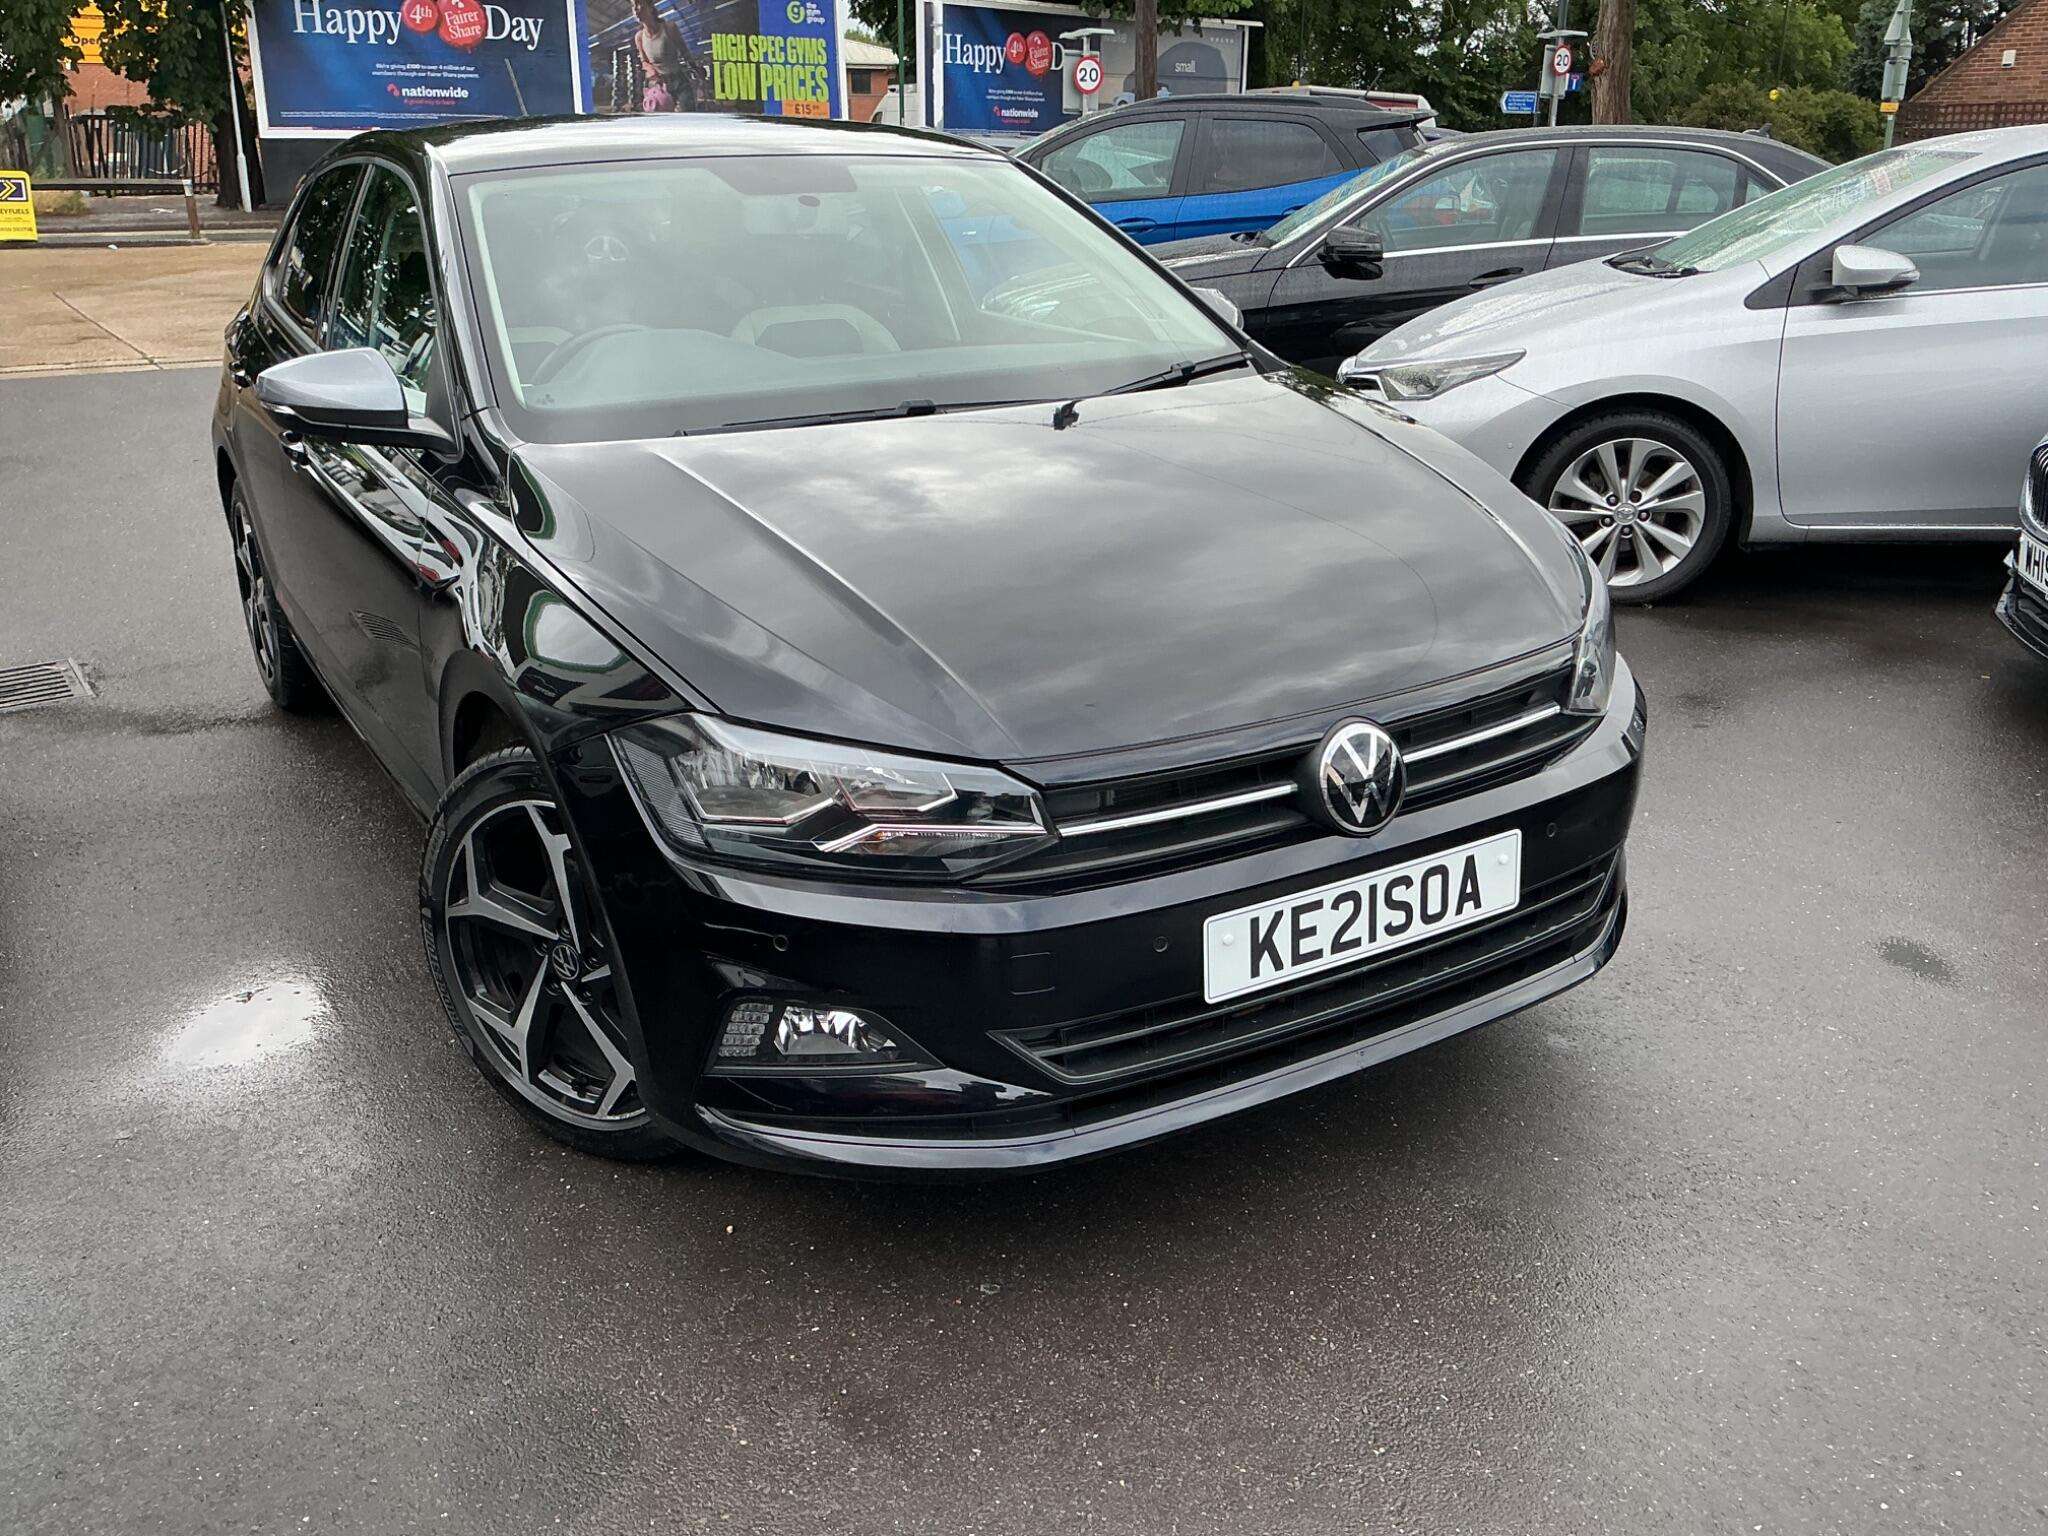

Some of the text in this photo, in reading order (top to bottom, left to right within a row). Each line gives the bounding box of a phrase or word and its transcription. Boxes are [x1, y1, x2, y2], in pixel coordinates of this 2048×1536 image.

[293, 0, 544, 51] Happy 4th Fairer Share Day
[711, 33, 828, 65] HIGH SPEC GYMS
[944, 33, 1006, 74] Happy
[1030, 57, 1050, 71] Share
[1556, 54, 1569, 67] 20
[1079, 67, 1099, 83] 20
[1174, 60, 1197, 73] small
[401, 86, 469, 98] nationwide
[712, 61, 829, 102] LOW PRICES
[1001, 107, 1039, 118] nationwide
[1249, 853, 1483, 980] KE21SOA
